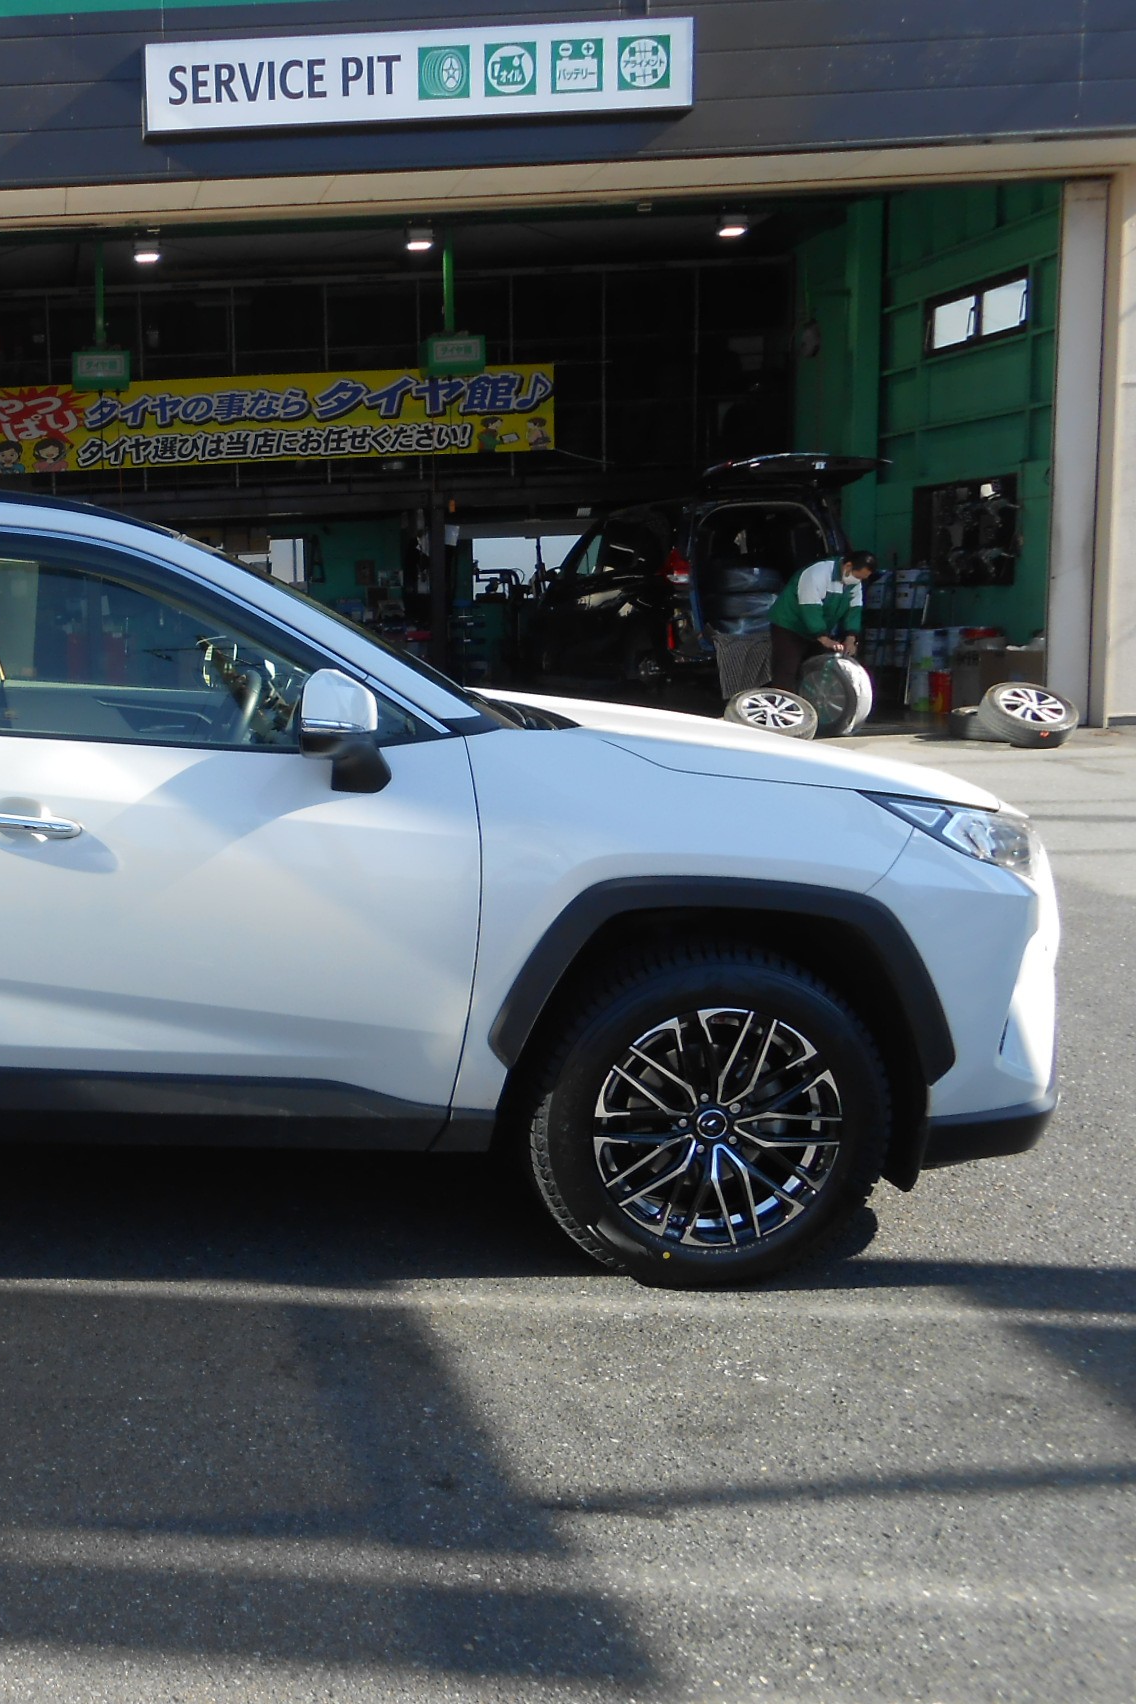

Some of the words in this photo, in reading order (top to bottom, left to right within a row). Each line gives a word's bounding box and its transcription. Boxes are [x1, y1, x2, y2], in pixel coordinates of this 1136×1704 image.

[622, 57, 665, 69] アライメント
[169, 58, 327, 106] SERVICE
[342, 54, 402, 97] PIT
[500, 69, 522, 83] オイル
[558, 67, 598, 81] バッテリー
